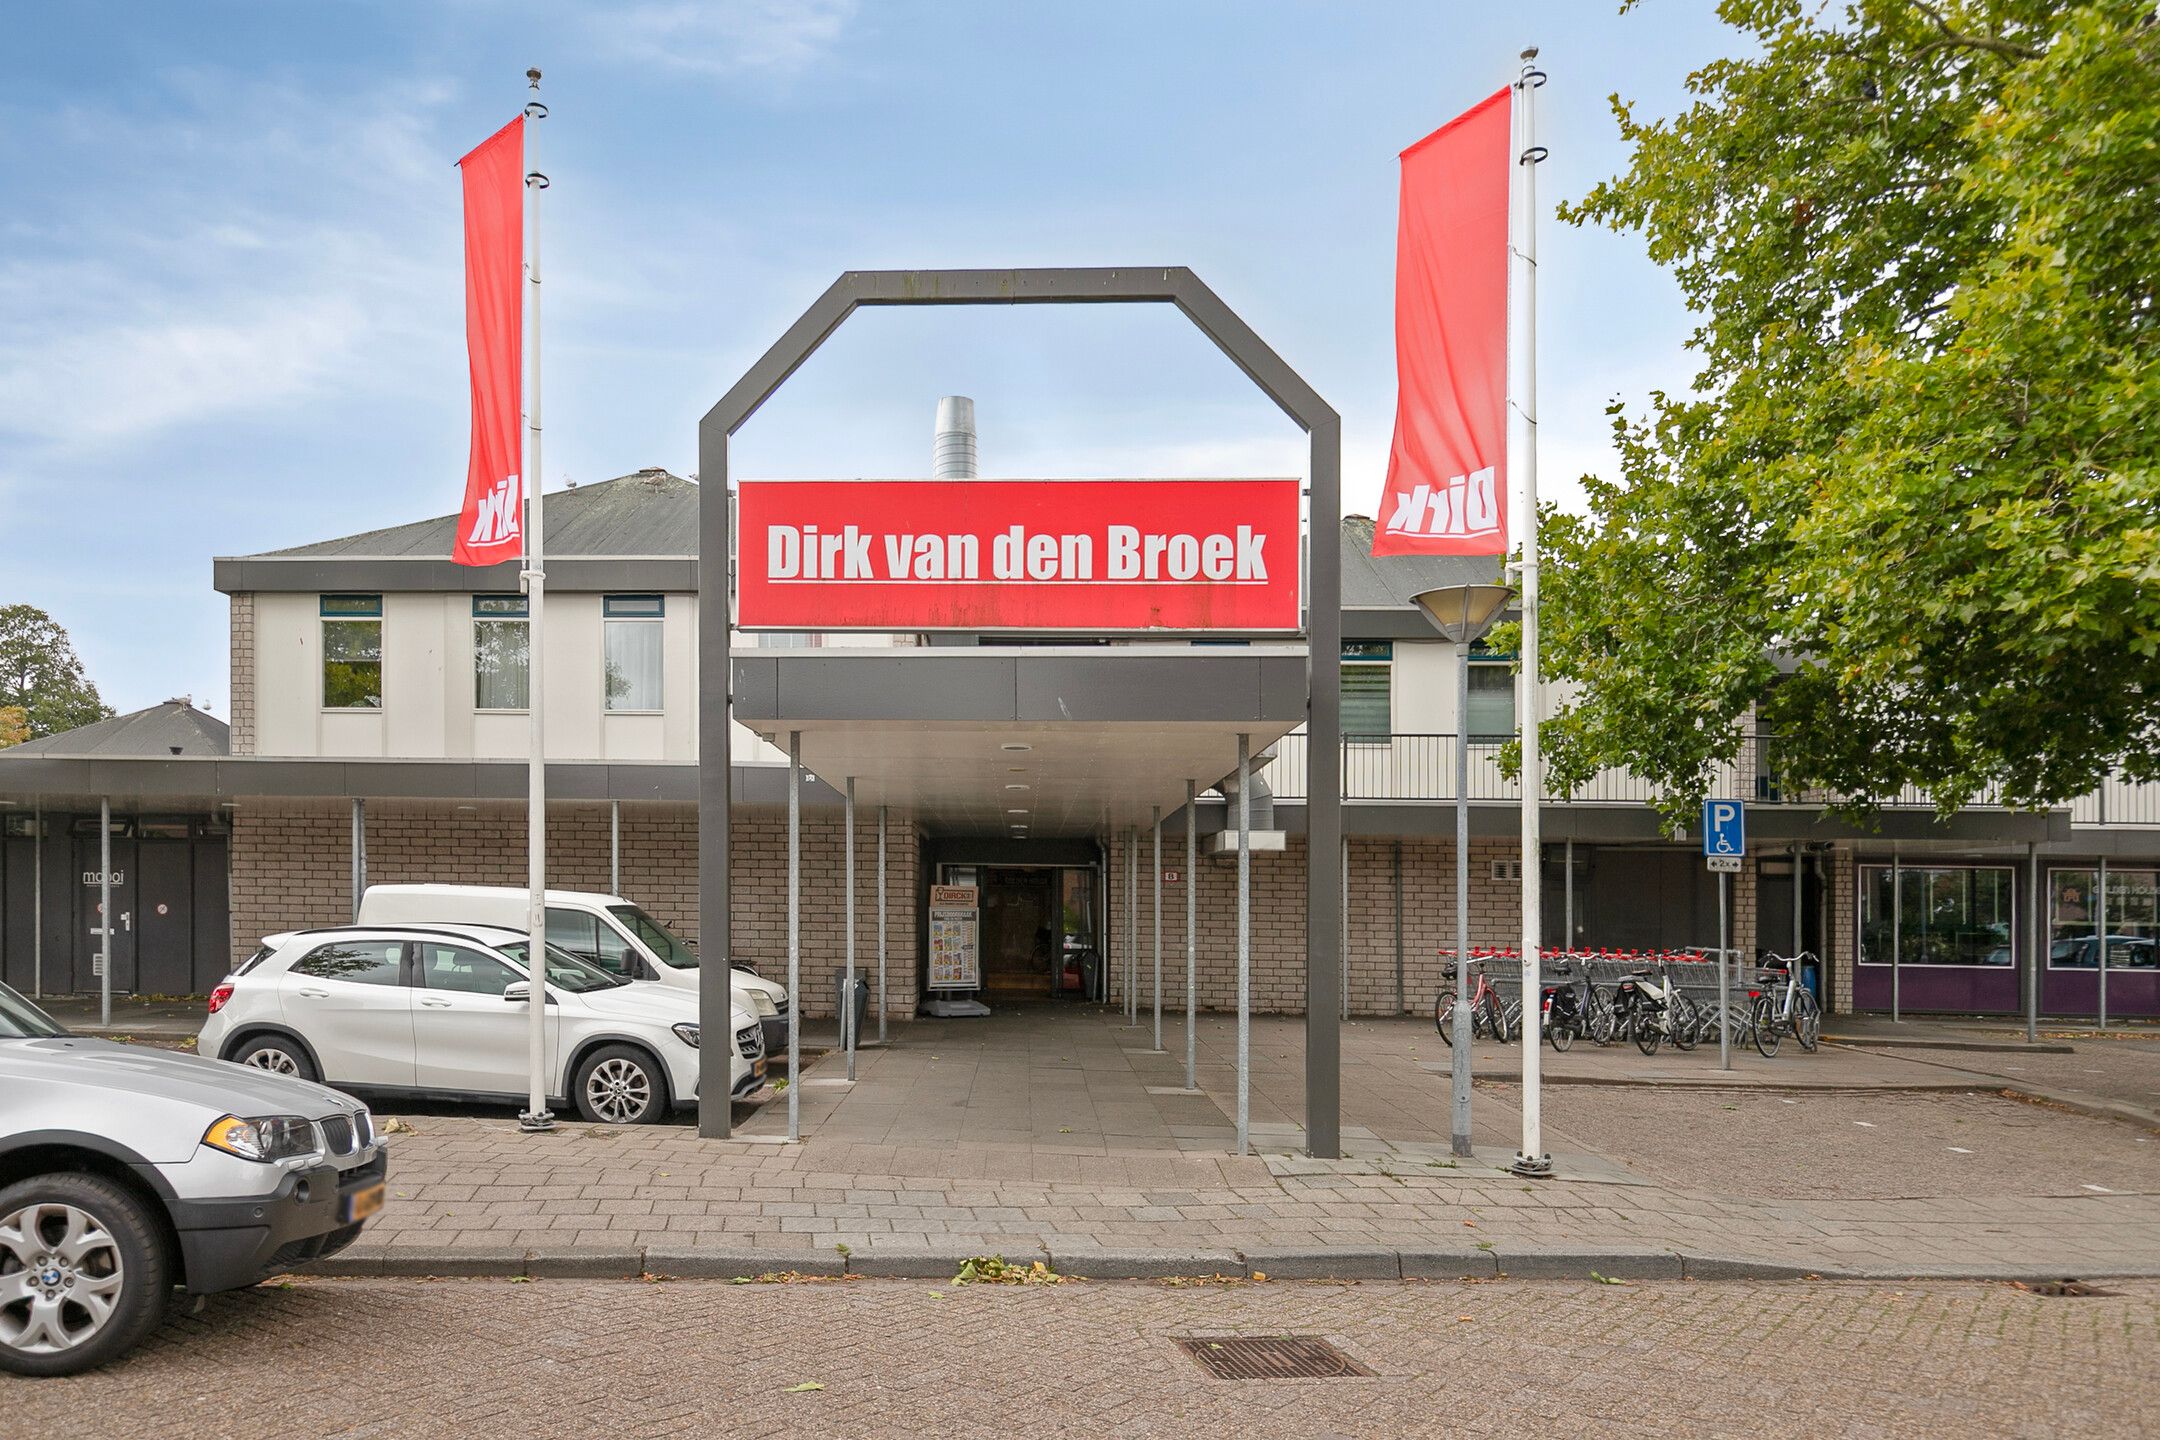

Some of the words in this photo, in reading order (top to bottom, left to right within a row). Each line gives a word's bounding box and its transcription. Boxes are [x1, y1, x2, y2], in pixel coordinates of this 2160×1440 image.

[768, 525, 873, 579] Dirk
[884, 533, 979, 580] van
[992, 525, 1092, 580] den
[1107, 525, 1267, 580] Broek
[1714, 804, 1735, 832] P
[83, 870, 124, 882] mooi
